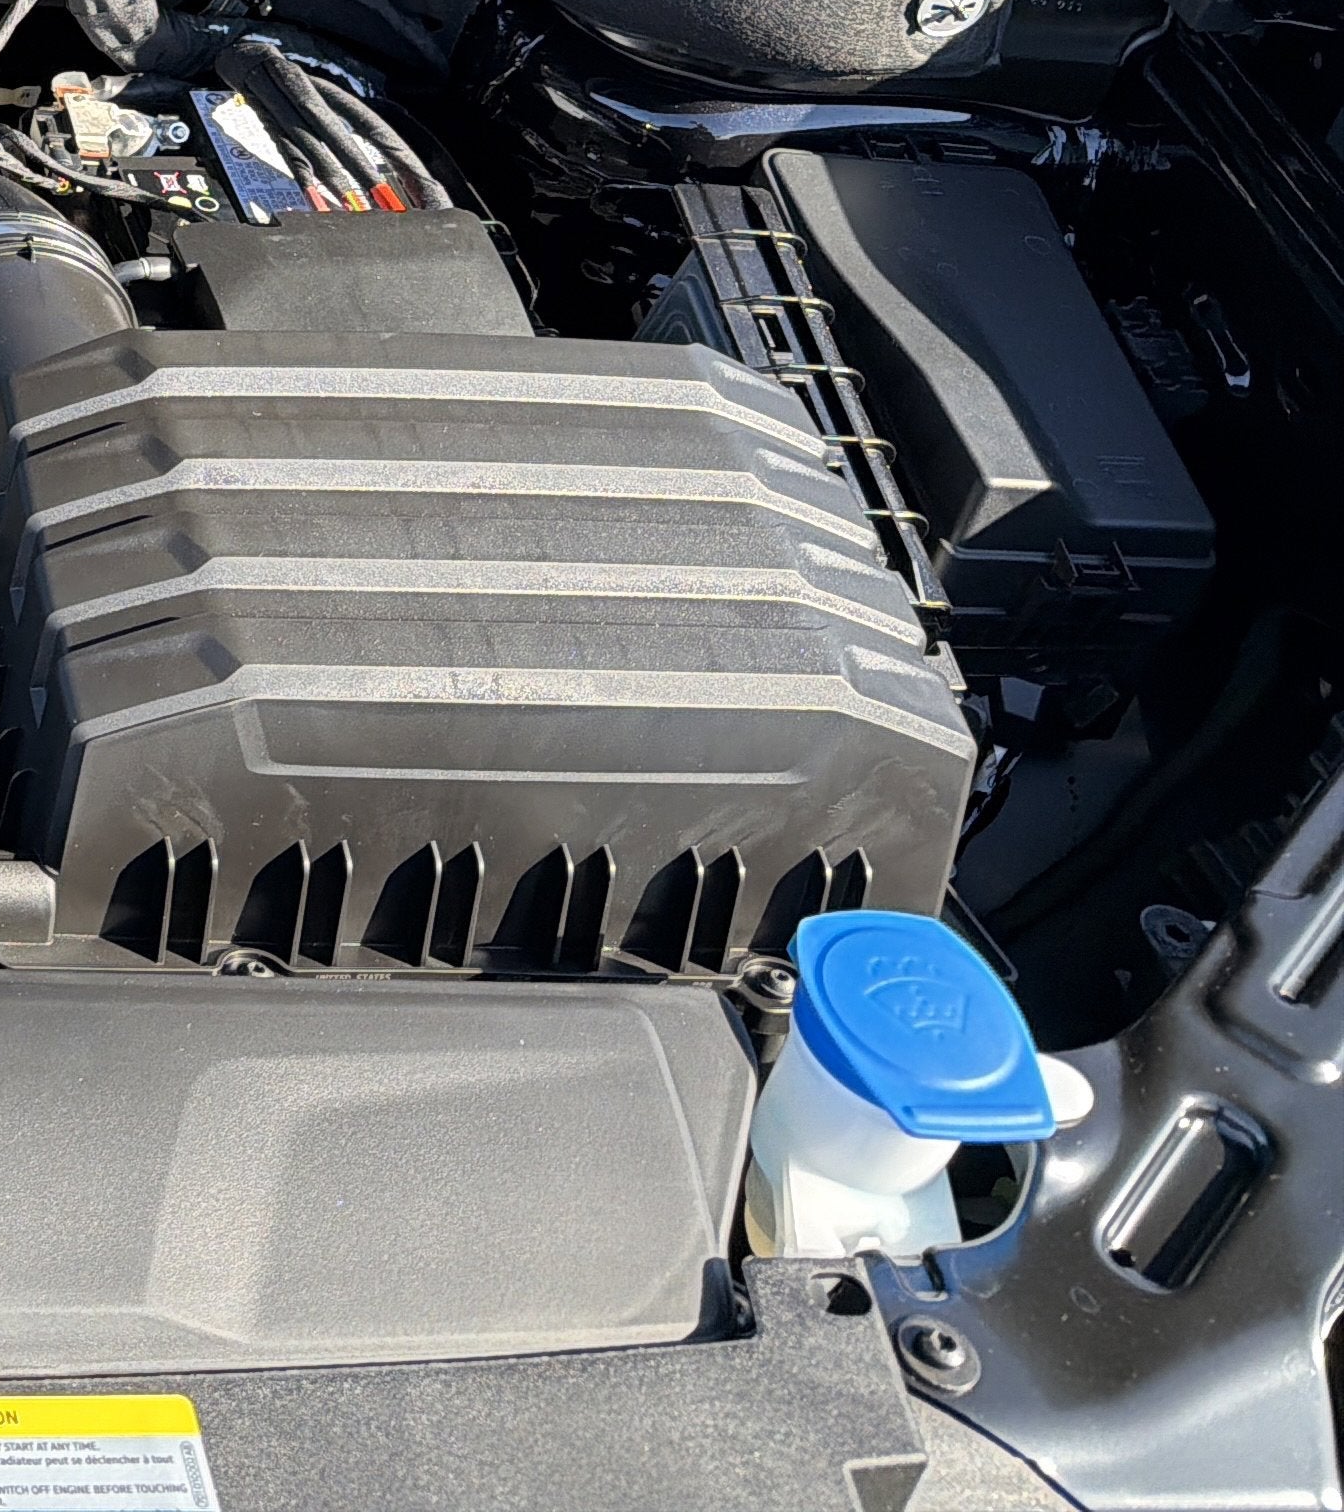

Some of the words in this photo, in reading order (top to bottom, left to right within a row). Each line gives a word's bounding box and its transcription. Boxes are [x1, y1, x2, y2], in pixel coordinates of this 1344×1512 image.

[4, 1442, 34, 1451] START
[36, 1442, 48, 1451] AT
[50, 1441, 70, 1451] ANY
[72, 1441, 101, 1451] TIME.
[44, 1456, 69, 1467] peut
[71, 1457, 83, 1465] se
[142, 1454, 150, 1464] à
[151, 1455, 174, 1464] tout
[31, 1485, 51, 1494] OFF
[52, 1485, 90, 1494] ENGINE
[93, 1484, 133, 1494] BEFORE
[135, 1483, 188, 1494] TOUCHING
